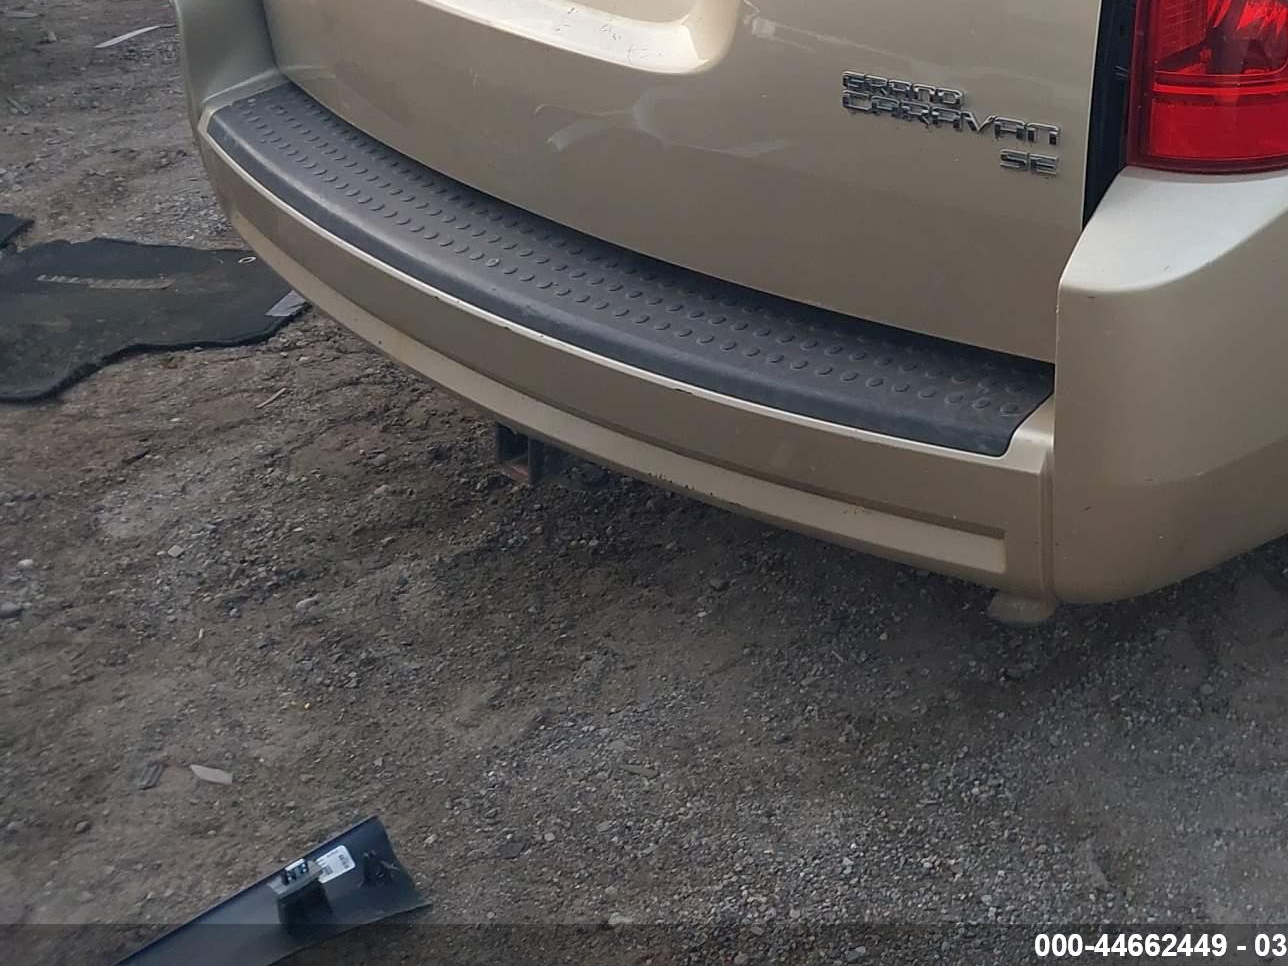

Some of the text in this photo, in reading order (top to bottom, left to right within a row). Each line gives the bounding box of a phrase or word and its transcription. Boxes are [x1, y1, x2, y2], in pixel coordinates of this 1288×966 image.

[842, 70, 964, 106] GRAND
[842, 90, 1061, 146] CARAVAN
[1000, 148, 1058, 176] SE
